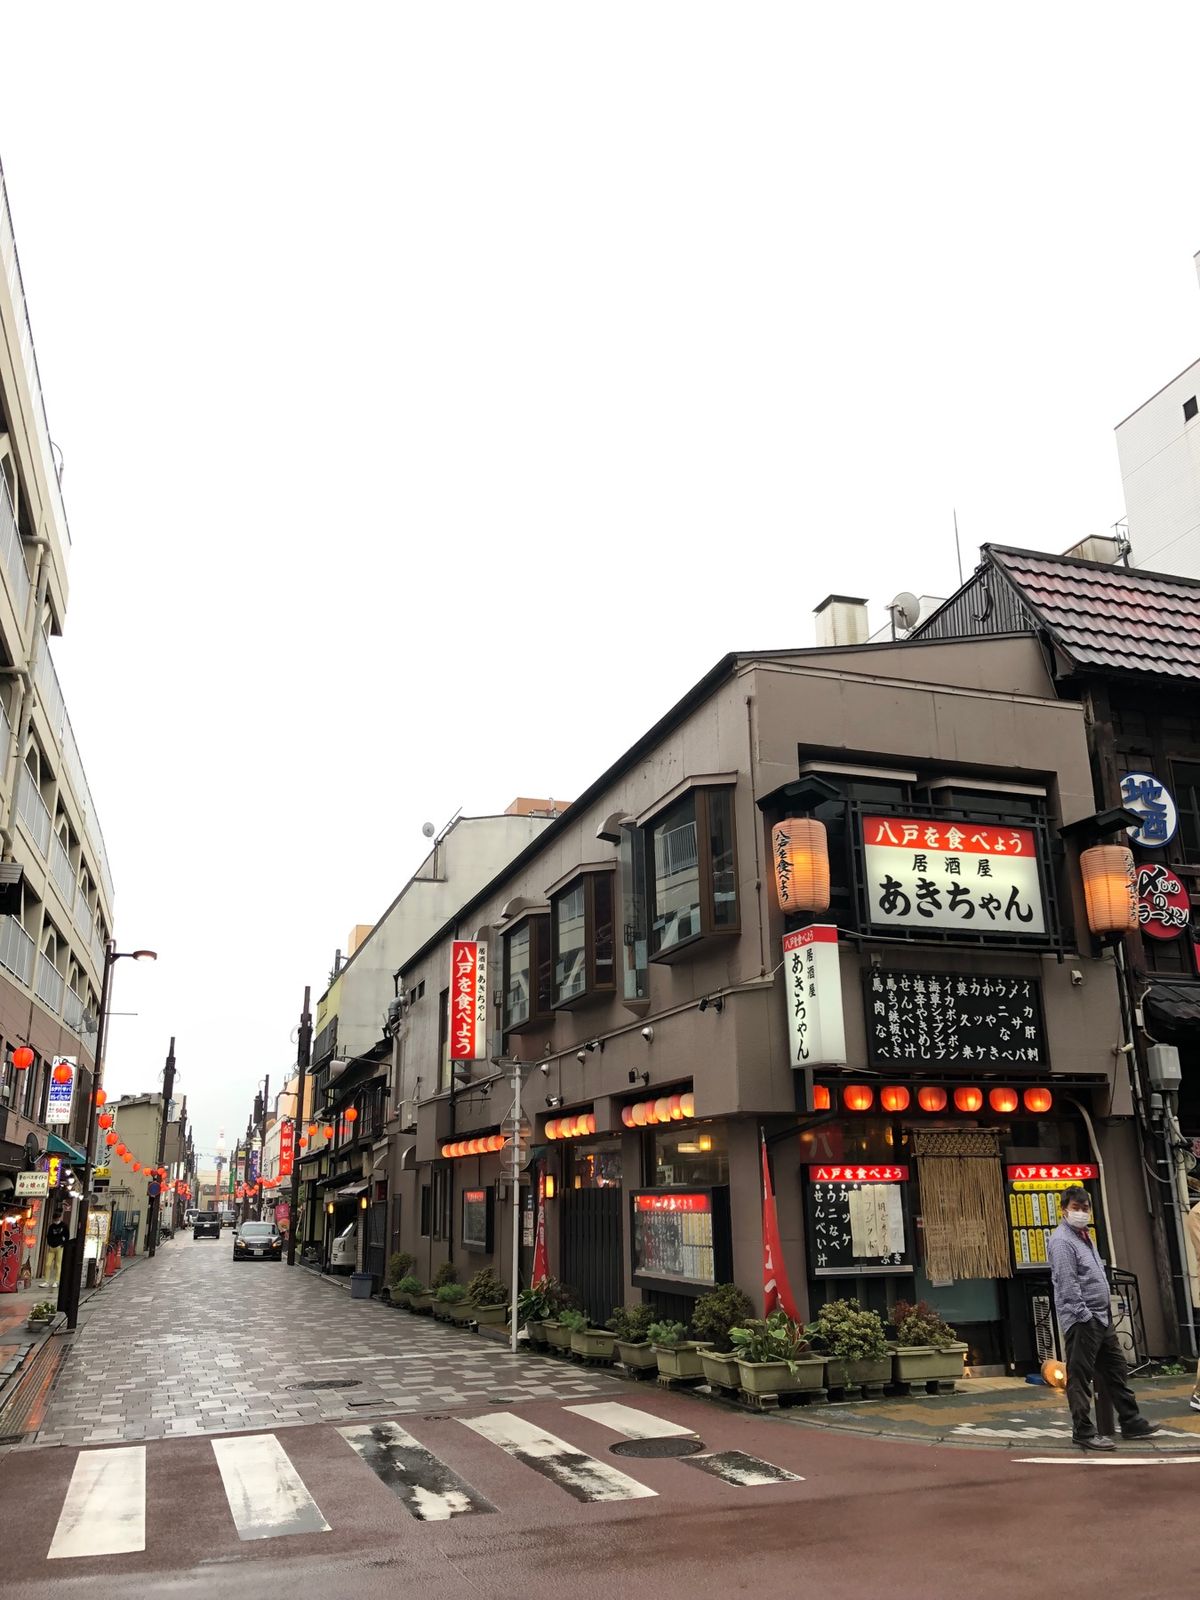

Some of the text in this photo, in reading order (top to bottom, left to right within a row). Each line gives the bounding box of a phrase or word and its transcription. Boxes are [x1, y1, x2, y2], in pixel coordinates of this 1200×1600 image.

[1121, 777, 1167, 842] 地酒
[879, 874, 1033, 923] あきちゃん
[912, 854, 993, 877] 居酒屋
[1139, 903, 1189, 927] ラーメン
[1154, 893, 1167, 911] の
[454, 946, 474, 1055] 八戸を食べよう
[476, 974, 486, 1022] あきちゃん
[791, 952, 810, 1061] あきちゃん
[806, 948, 816, 998] 居酒屋
[872, 977, 890, 1058] 馬肉なべ
[885, 977, 902, 1059] 馬もつ鉄板やき
[899, 979, 917, 1059] せんべい汁
[913, 980, 931, 1060] 塩辛やきめし
[982, 984, 999, 1060] かやき
[995, 983, 1014, 1061] ウニなべ
[1021, 985, 1039, 1062] イカ肝刺
[816, 1167, 902, 1180] 八戸を食べよう
[1014, 1166, 1092, 1178] 八戸を食べよう
[813, 1190, 828, 1267] せんべい汁
[827, 1190, 840, 1250] ウニなべ
